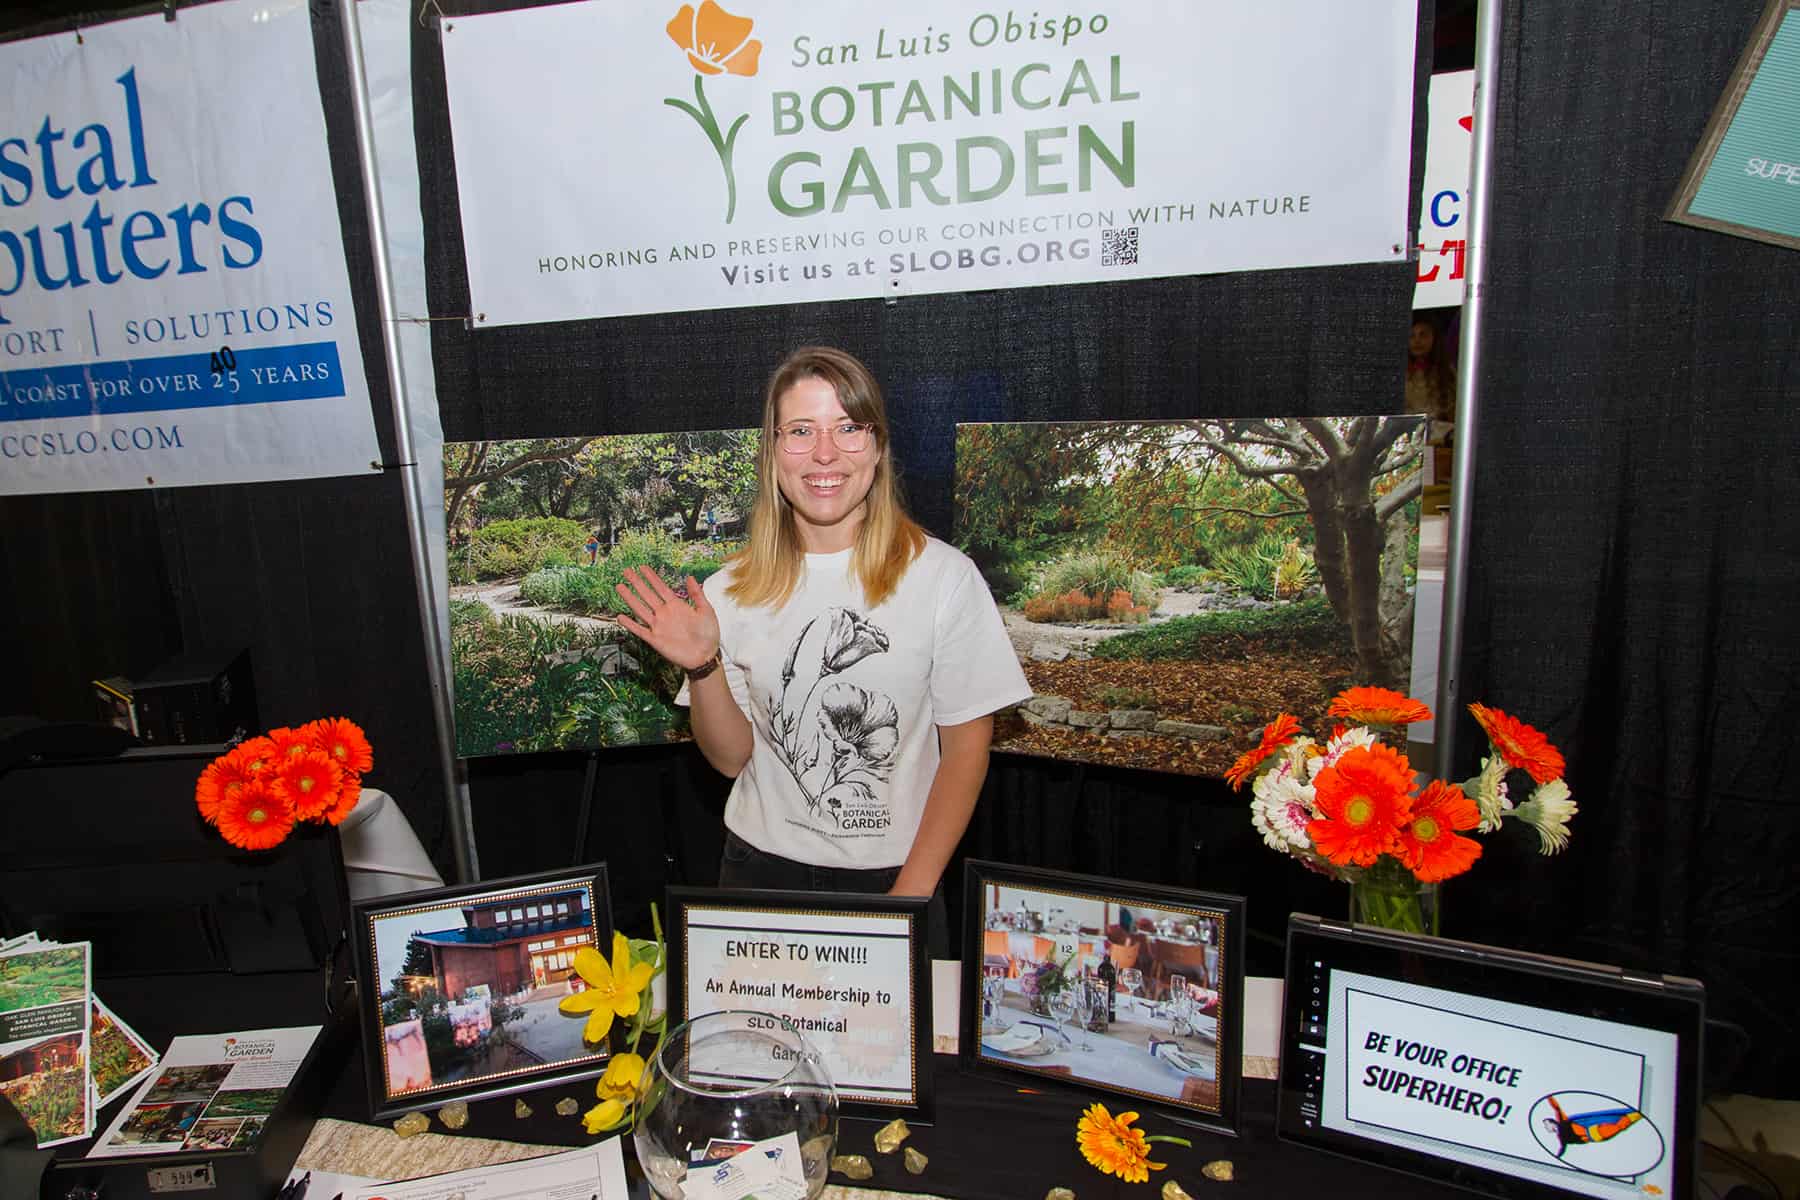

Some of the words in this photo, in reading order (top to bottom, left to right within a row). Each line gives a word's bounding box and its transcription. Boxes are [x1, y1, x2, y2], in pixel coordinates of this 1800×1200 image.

[792, 36, 859, 68] San
[876, 27, 951, 59] Luis
[969, 11, 1109, 46] Obispo
[772, 55, 1141, 137] BOTANICAL
[767, 120, 1136, 218] GARDEN
[539, 248, 658, 274] HONORING
[668, 243, 716, 263] AND
[728, 230, 866, 257] PRESERVING
[878, 228, 929, 246] OUR
[941, 209, 1114, 241] CONNECTION
[1127, 203, 1195, 226] WITH
[1208, 195, 1312, 219] NATURE
[721, 264, 790, 286] Visit
[803, 261, 833, 280] us
[847, 256, 876, 277] at
[888, 239, 1092, 275] SLOBG.ORG
[0, 328, 64, 357] ORT
[127, 301, 334, 345] SOLUTIONS
[210, 345, 237, 374] 40
[15, 383, 82, 405] COAST
[90, 379, 133, 399] FOR
[140, 374, 203, 394] OVER
[211, 370, 240, 395] 25
[250, 361, 330, 386] YEARS
[1, 425, 185, 458] CCSLO.COM
[842, 809, 890, 818] BOTANICAL
[842, 816, 891, 830] GARDEN
[726, 940, 780, 960] ENTER
[786, 944, 809, 961] TO
[814, 946, 868, 965] WIN!!!
[705, 978, 724, 994] An
[729, 979, 776, 998] Annual
[782, 983, 870, 1006] Membership
[875, 990, 891, 1004] to
[747, 1016, 775, 1030] SLO
[781, 1013, 848, 1033] Botanical
[230, 1048, 274, 1056] GARDEN
[1364, 1031, 1391, 1053] BE
[1395, 1038, 1448, 1069] YOUR
[1451, 1053, 1523, 1089] OFFICE
[1363, 1065, 1514, 1126] SUPERHERO!
